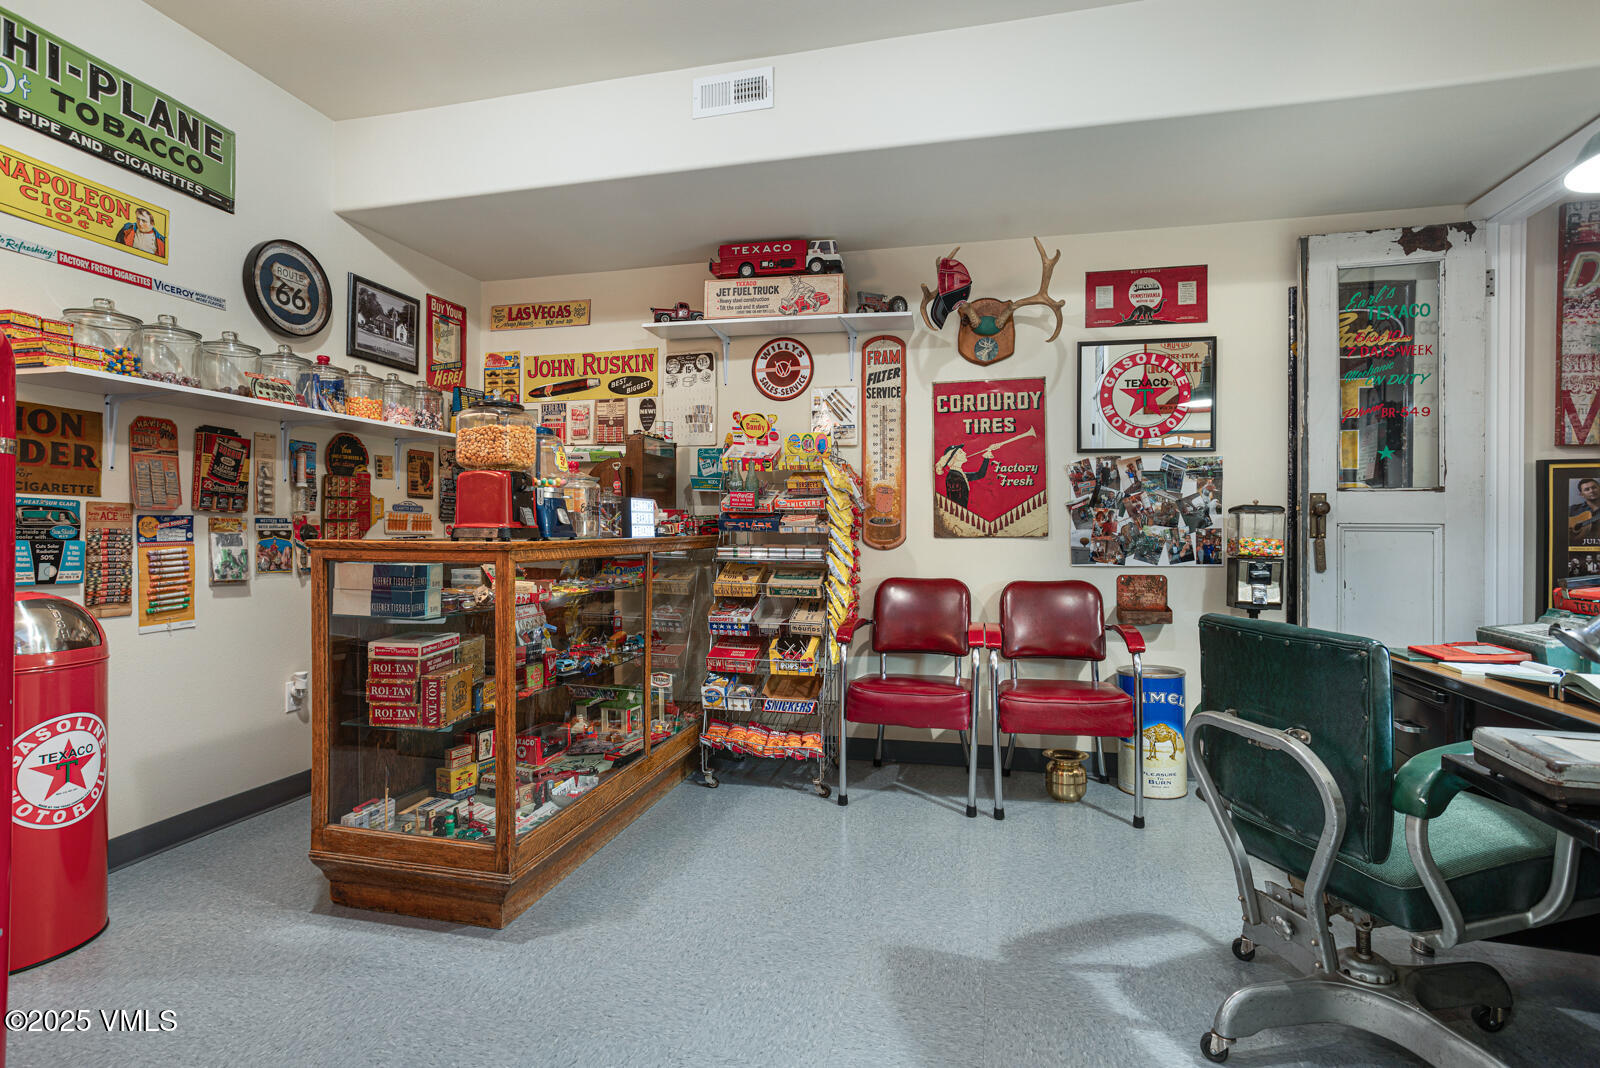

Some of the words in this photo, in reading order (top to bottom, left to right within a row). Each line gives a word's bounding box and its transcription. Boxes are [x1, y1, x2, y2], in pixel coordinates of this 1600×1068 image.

[0, 15, 225, 164] HI-PLANE
[50, 87, 204, 174] TOBACCO
[18, 108, 61, 136] PIPE
[69, 131, 103, 153] AND
[113, 151, 204, 196] CIGARETTES
[0, 154, 131, 221] NAPOLEON
[19, 184, 114, 229] CIGAR
[731, 244, 792, 255] TEXACO
[5, 238, 57, 260] Refreshing!
[91, 264, 113, 276] FRESH
[114, 269, 151, 287] CIGARETTES
[276, 266, 305, 282] ROUTE
[275, 282, 306, 311] 66
[716, 288, 730, 298] JET
[732, 287, 751, 297] FUEL
[753, 285, 779, 296] TRUCK
[1345, 284, 1396, 312] Earl's
[431, 298, 444, 314] BUY
[446, 303, 463, 320] YOUR
[508, 306, 532, 322] LAS
[531, 304, 571, 320] VEGAS
[1366, 303, 1431, 321] TEXACO
[761, 343, 804, 360] WILLYS
[866, 350, 900, 365] FRAM
[1347, 347, 1356, 358] 7
[1360, 346, 1395, 358] DAYS
[1400, 344, 1432, 356] WEEK
[527, 356, 575, 379] JOHN
[582, 353, 654, 376] RUSKIN
[1104, 353, 1189, 387] GASOLINE
[433, 369, 464, 386] HERE!
[610, 377, 627, 389] BEST
[866, 367, 901, 386] FILTER
[1125, 378, 1169, 388] TEXACO
[1365, 375, 1386, 386] ON
[1387, 373, 1431, 385] DUTY
[626, 380, 651, 394] BIGGEST
[866, 386, 901, 399] SERVICE
[936, 391, 1043, 413] CORDUROY
[1381, 406, 1431, 418] BR-549
[963, 417, 1016, 434] TIRES
[1102, 404, 1161, 438] MOTOR
[1165, 405, 1189, 429] OIL
[991, 460, 1039, 474] Factory
[997, 474, 1034, 487] Fresh
[100, 512, 119, 521] ACE
[373, 663, 414, 673] ROI-TAN
[780, 661, 800, 671] POPS
[371, 686, 411, 696] ROI-TAN
[428, 681, 437, 724] ROI-TAN
[764, 700, 815, 714] SNICKERS
[1142, 691, 1185, 709] MEL
[374, 708, 416, 718] ROI-TAN
[39, 743, 94, 765] TEXACO
